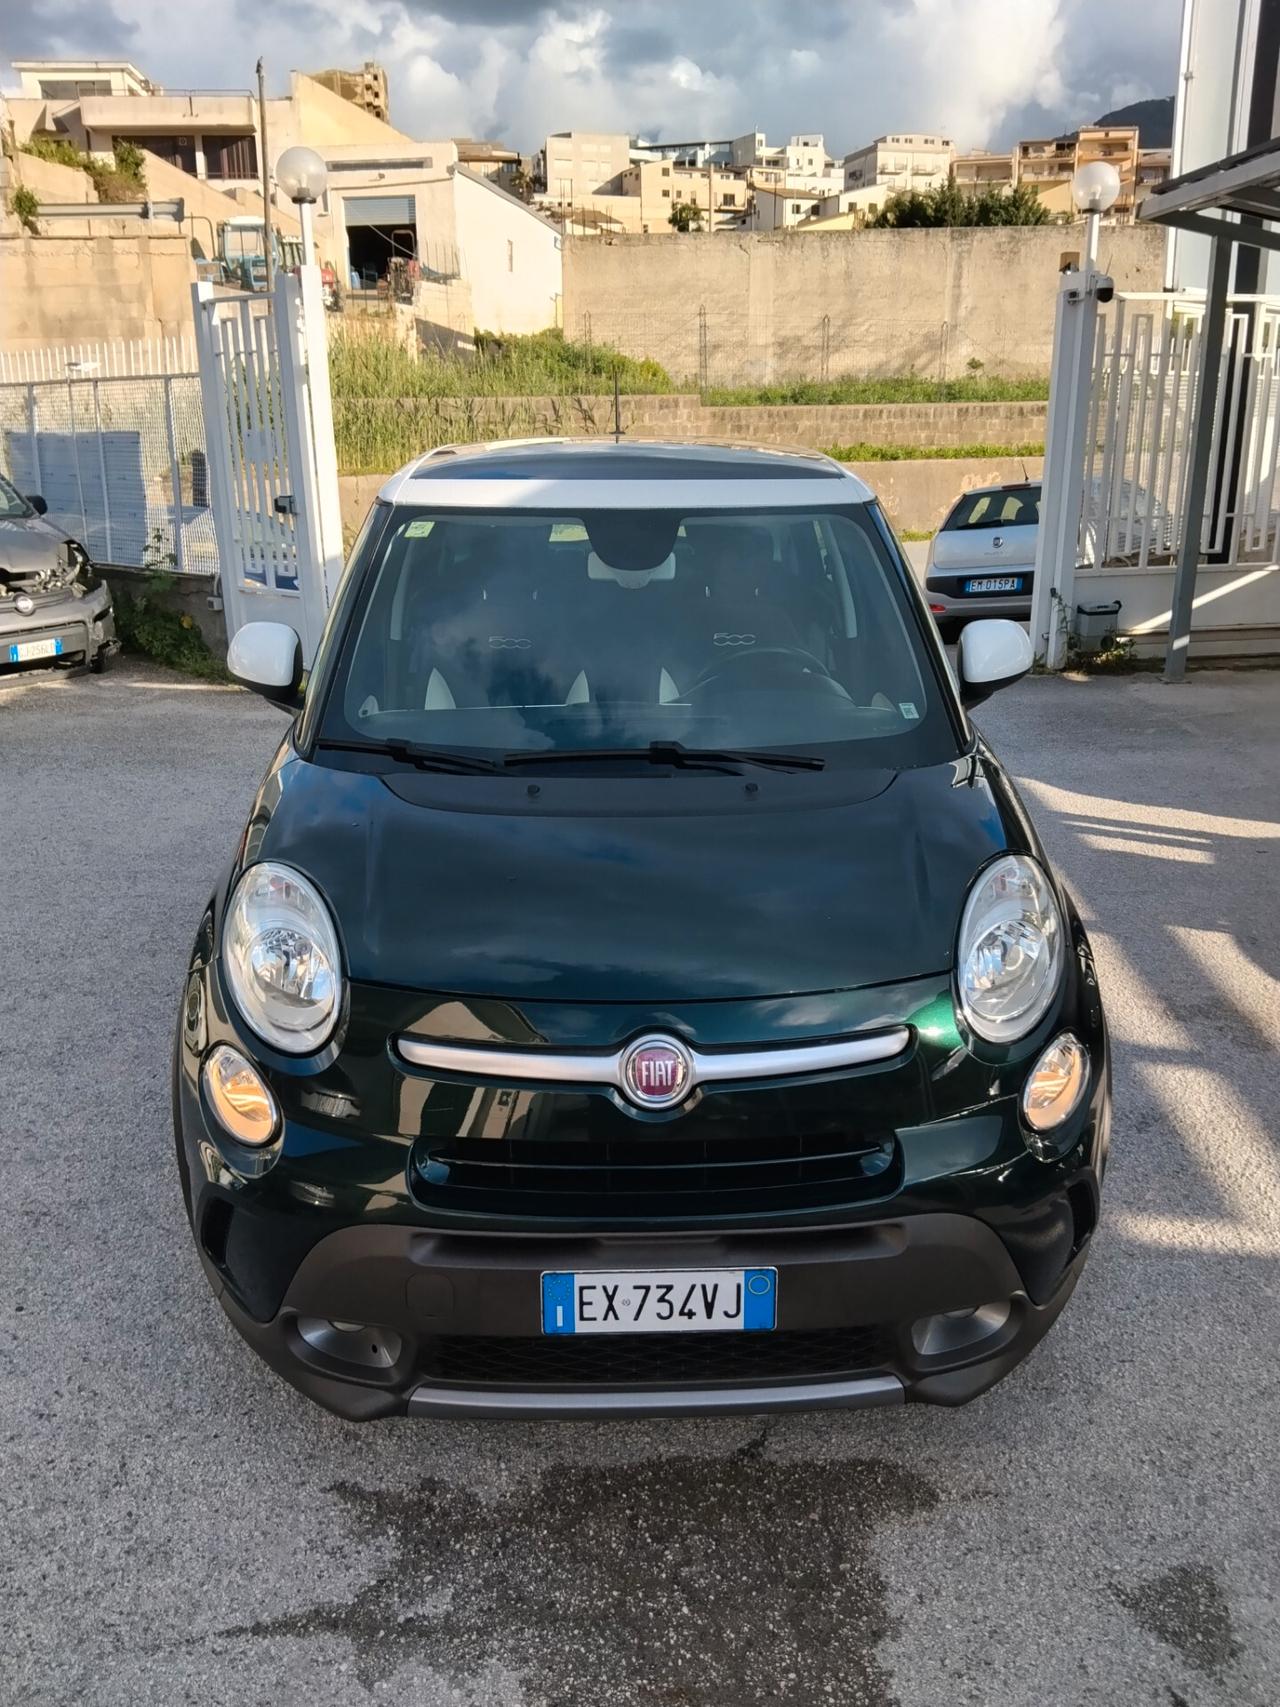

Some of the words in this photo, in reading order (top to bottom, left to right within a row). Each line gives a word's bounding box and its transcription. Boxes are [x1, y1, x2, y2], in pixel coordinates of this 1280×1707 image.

[488, 635, 532, 649] 500
[713, 632, 756, 646] 500
[641, 1060, 674, 1087] FIAT
